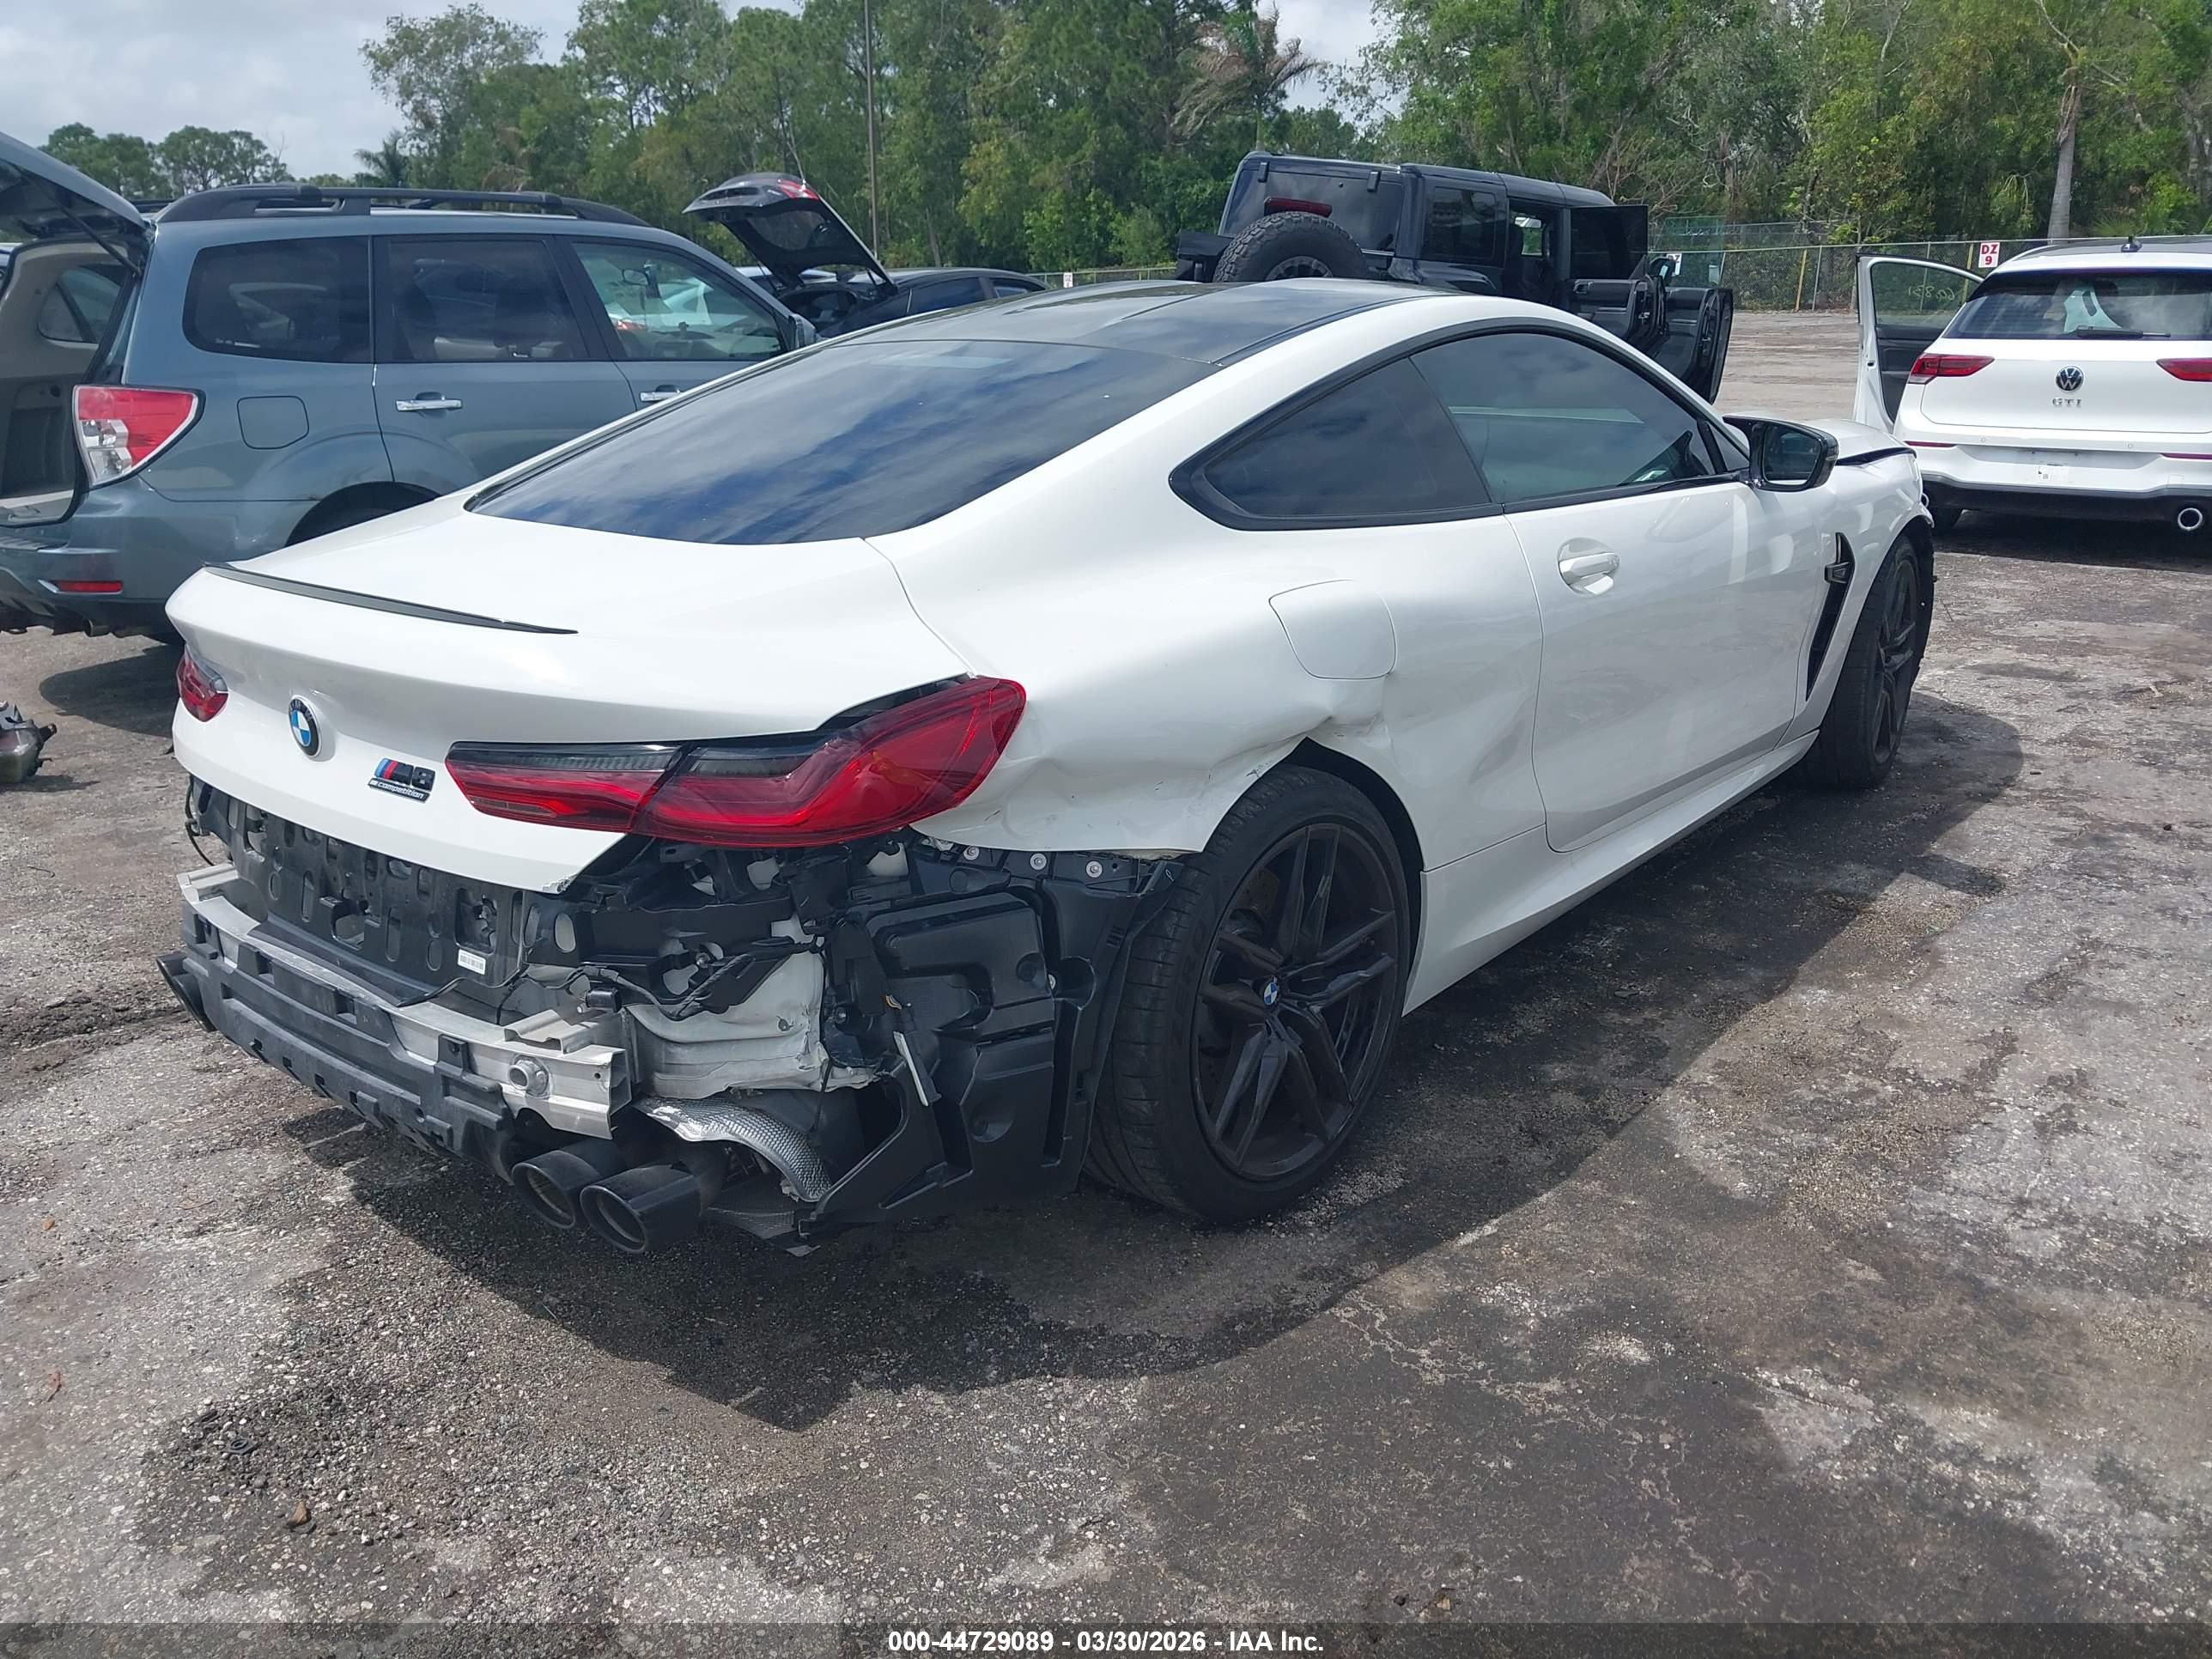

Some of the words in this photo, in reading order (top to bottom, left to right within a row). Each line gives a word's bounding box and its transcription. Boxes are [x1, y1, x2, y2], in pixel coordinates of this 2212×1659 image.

[1981, 244, 1998, 254] DZ
[1984, 255, 1993, 265] 9
[2052, 398, 2081, 406] GTI
